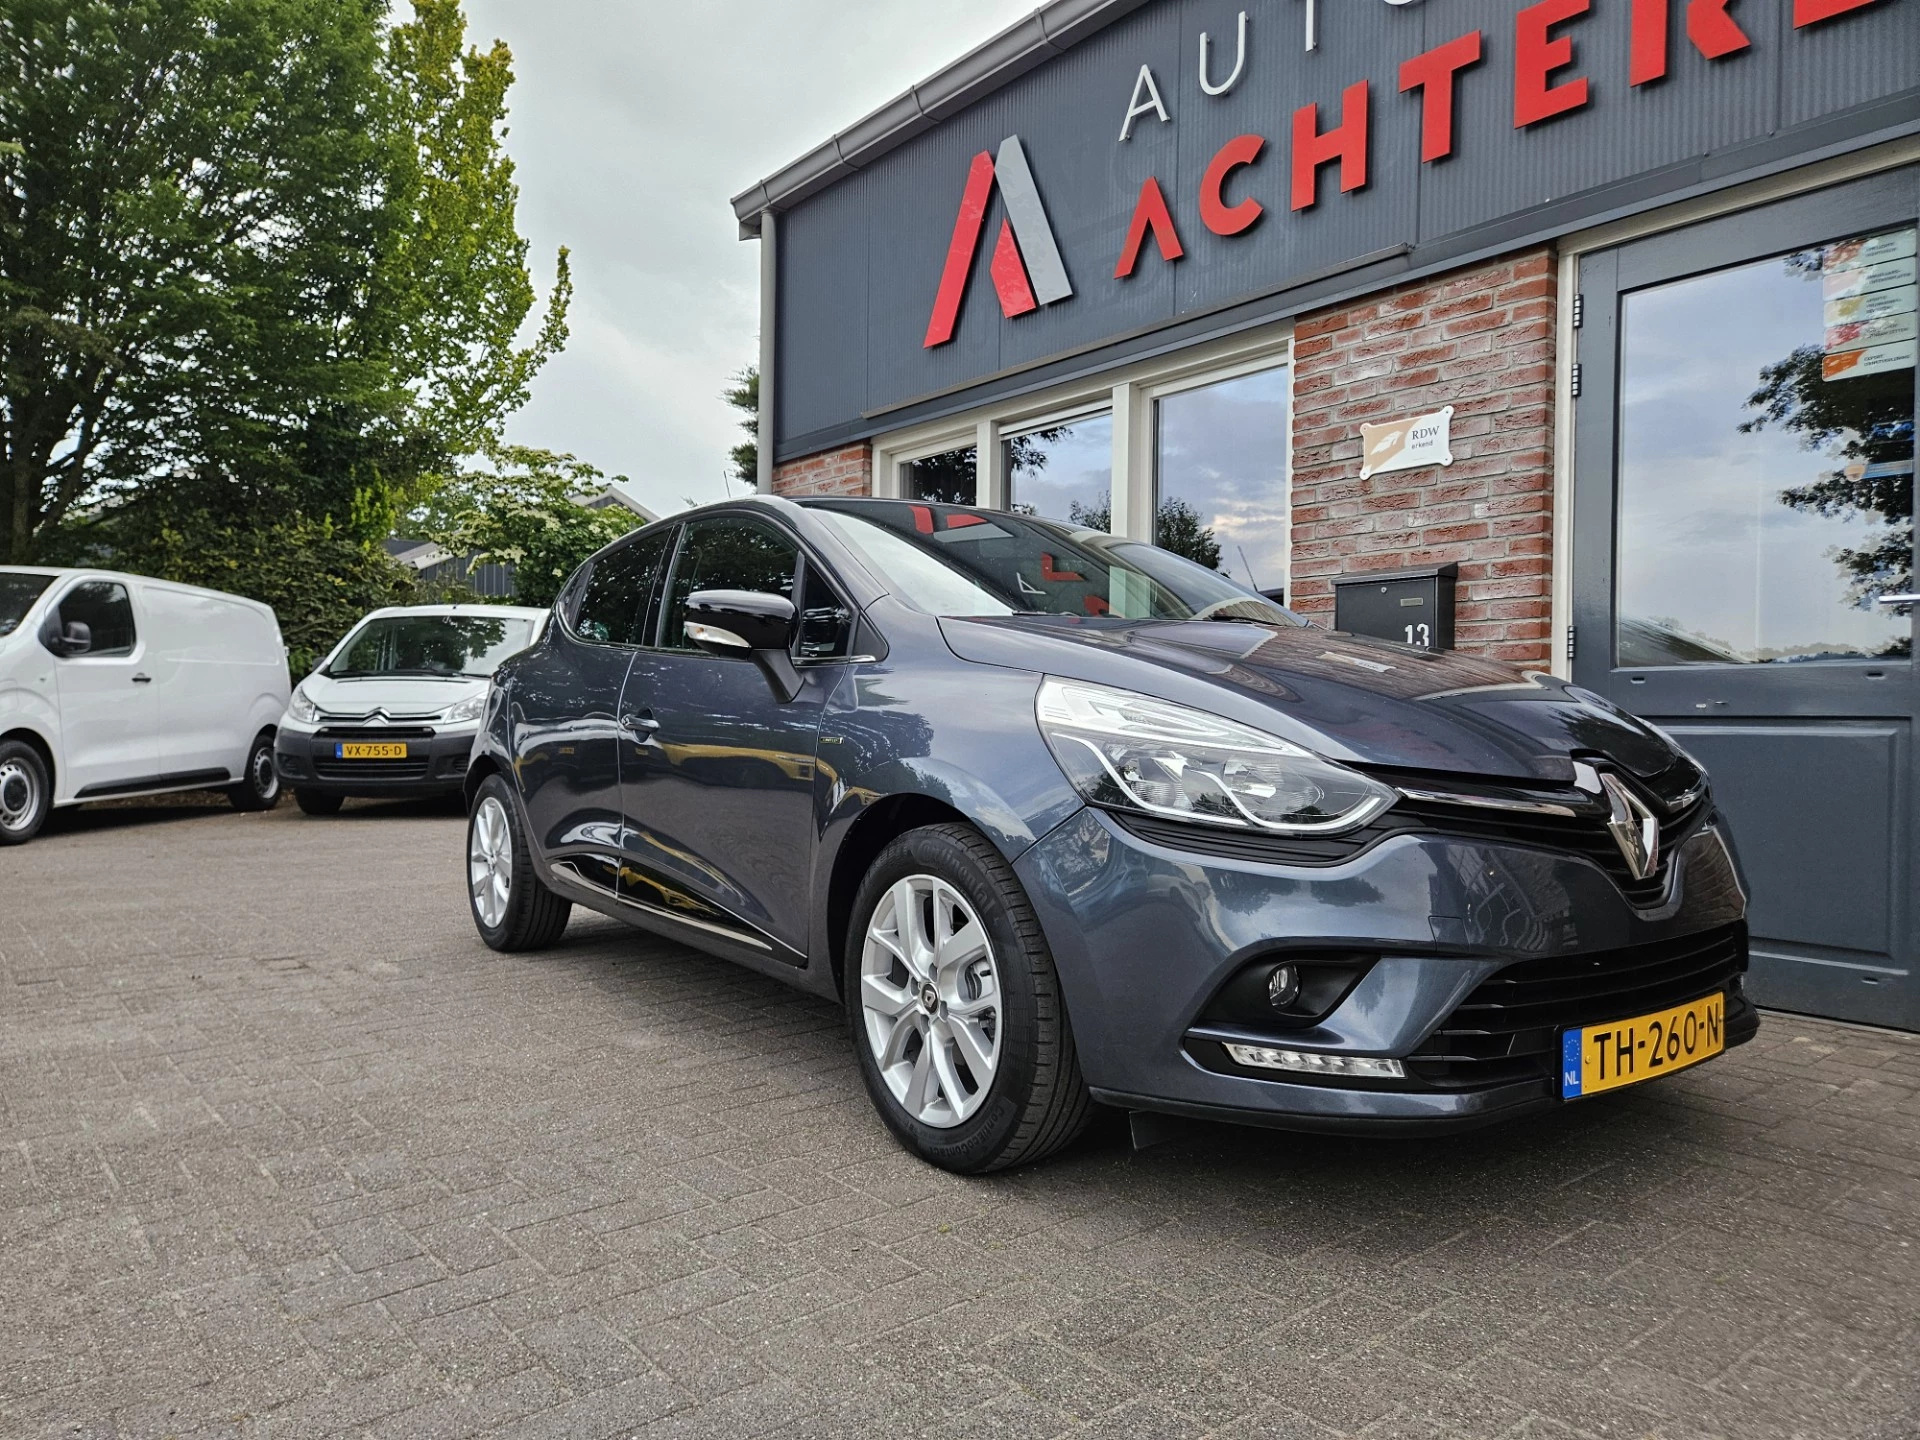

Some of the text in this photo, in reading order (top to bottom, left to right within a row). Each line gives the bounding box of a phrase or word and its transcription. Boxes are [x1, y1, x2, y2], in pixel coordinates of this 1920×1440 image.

[1118, 0, 1426, 142] AU
[1113, 0, 1877, 279] ACHTER
[1411, 425, 1439, 440] RDW
[1411, 440, 1433, 450] erkend
[1404, 623, 1429, 647] 13
[346, 745, 402, 756] VX-755-D
[1593, 1002, 1719, 1080] TH-260-N
[1564, 1070, 1579, 1087] NL
